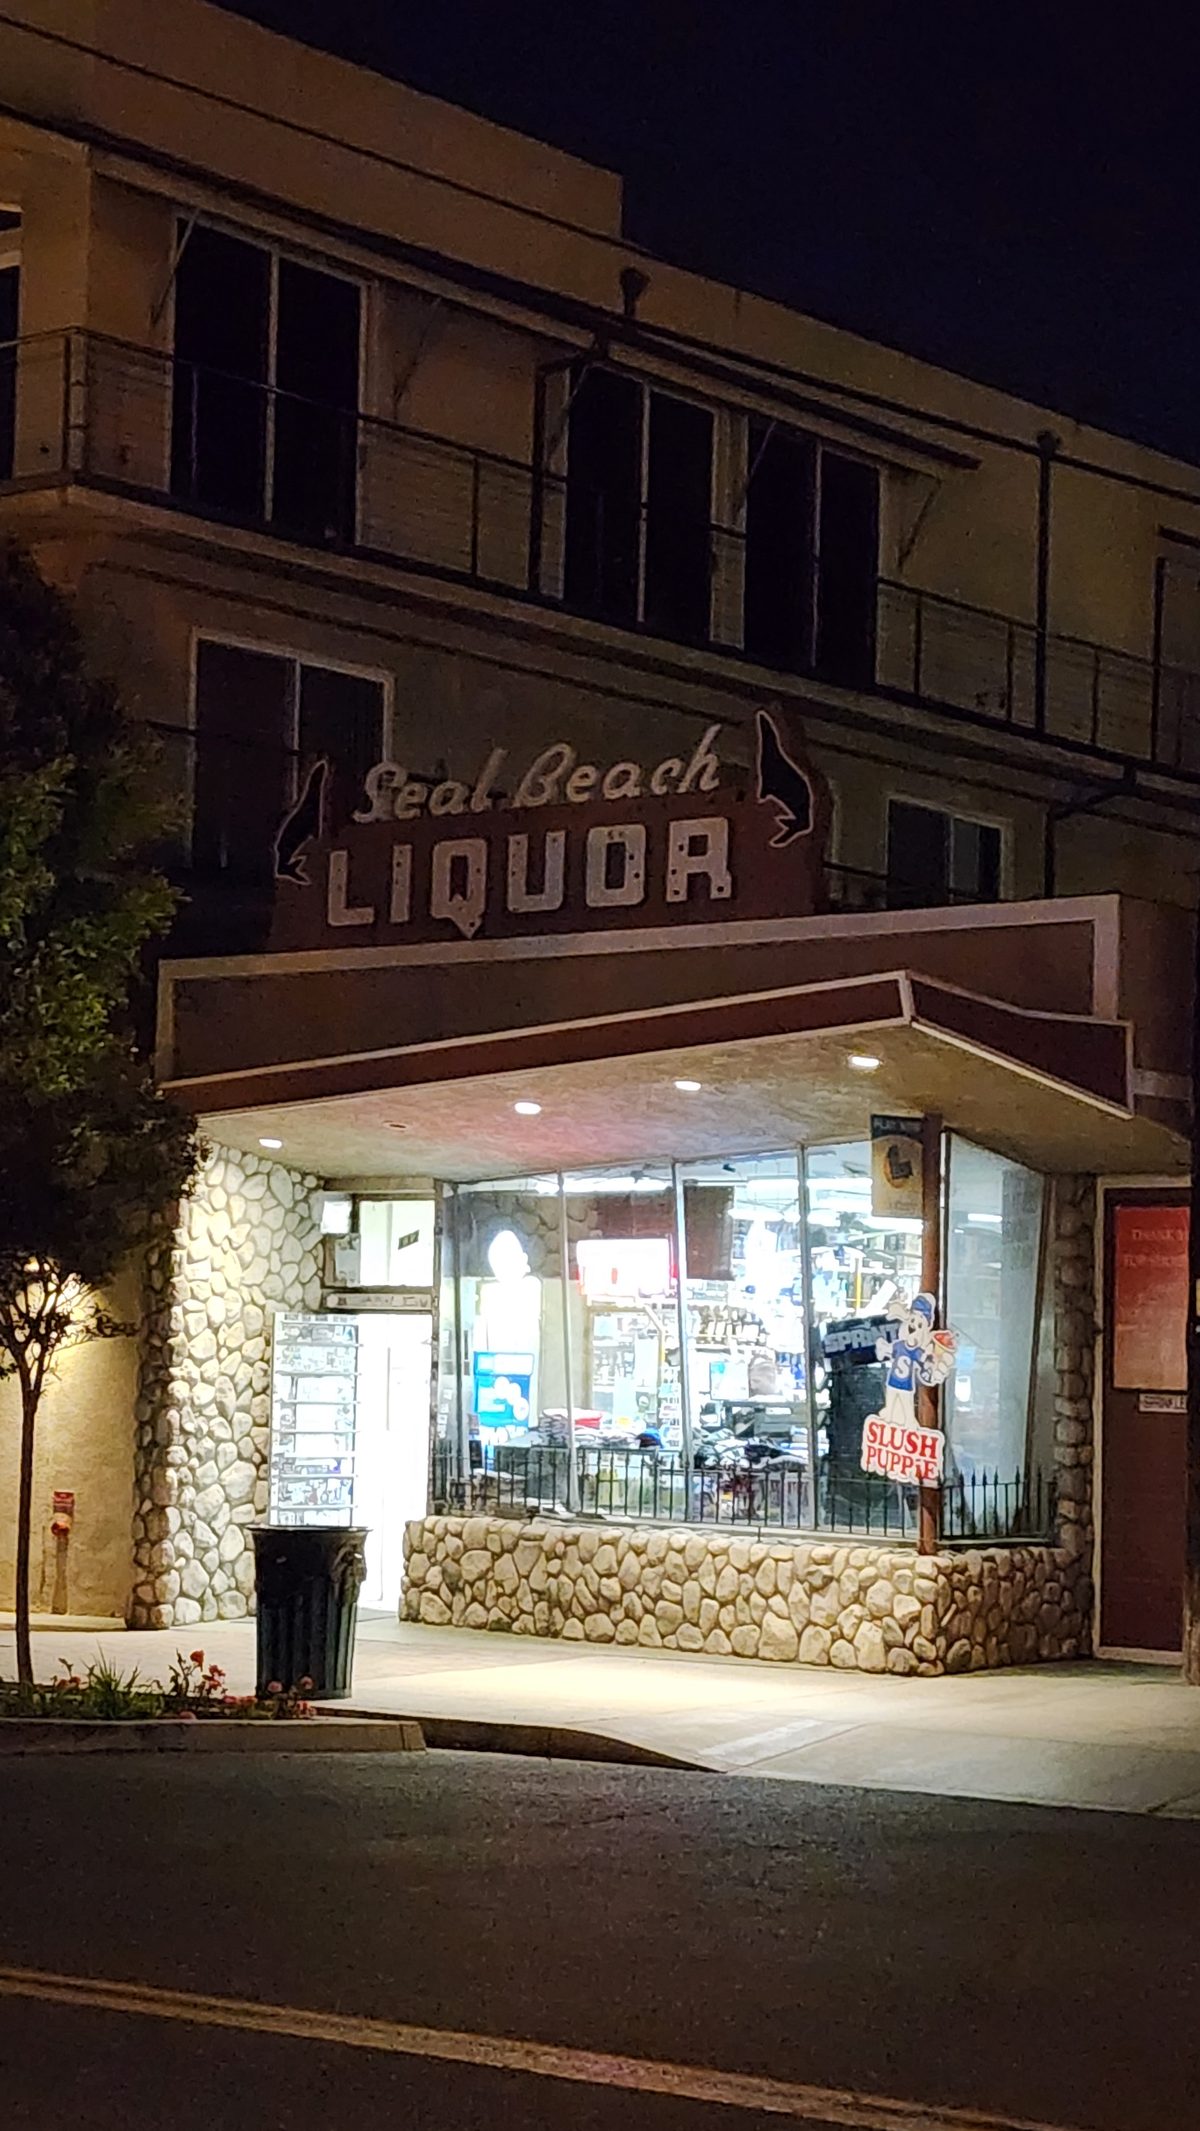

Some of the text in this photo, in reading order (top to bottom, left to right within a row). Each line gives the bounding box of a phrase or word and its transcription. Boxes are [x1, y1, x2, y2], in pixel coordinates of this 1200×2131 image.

[352, 723, 722, 824] Seal Beach
[327, 816, 732, 940] LIQUOR
[895, 1356, 911, 1378] S
[866, 1421, 940, 1460] SLUSH
